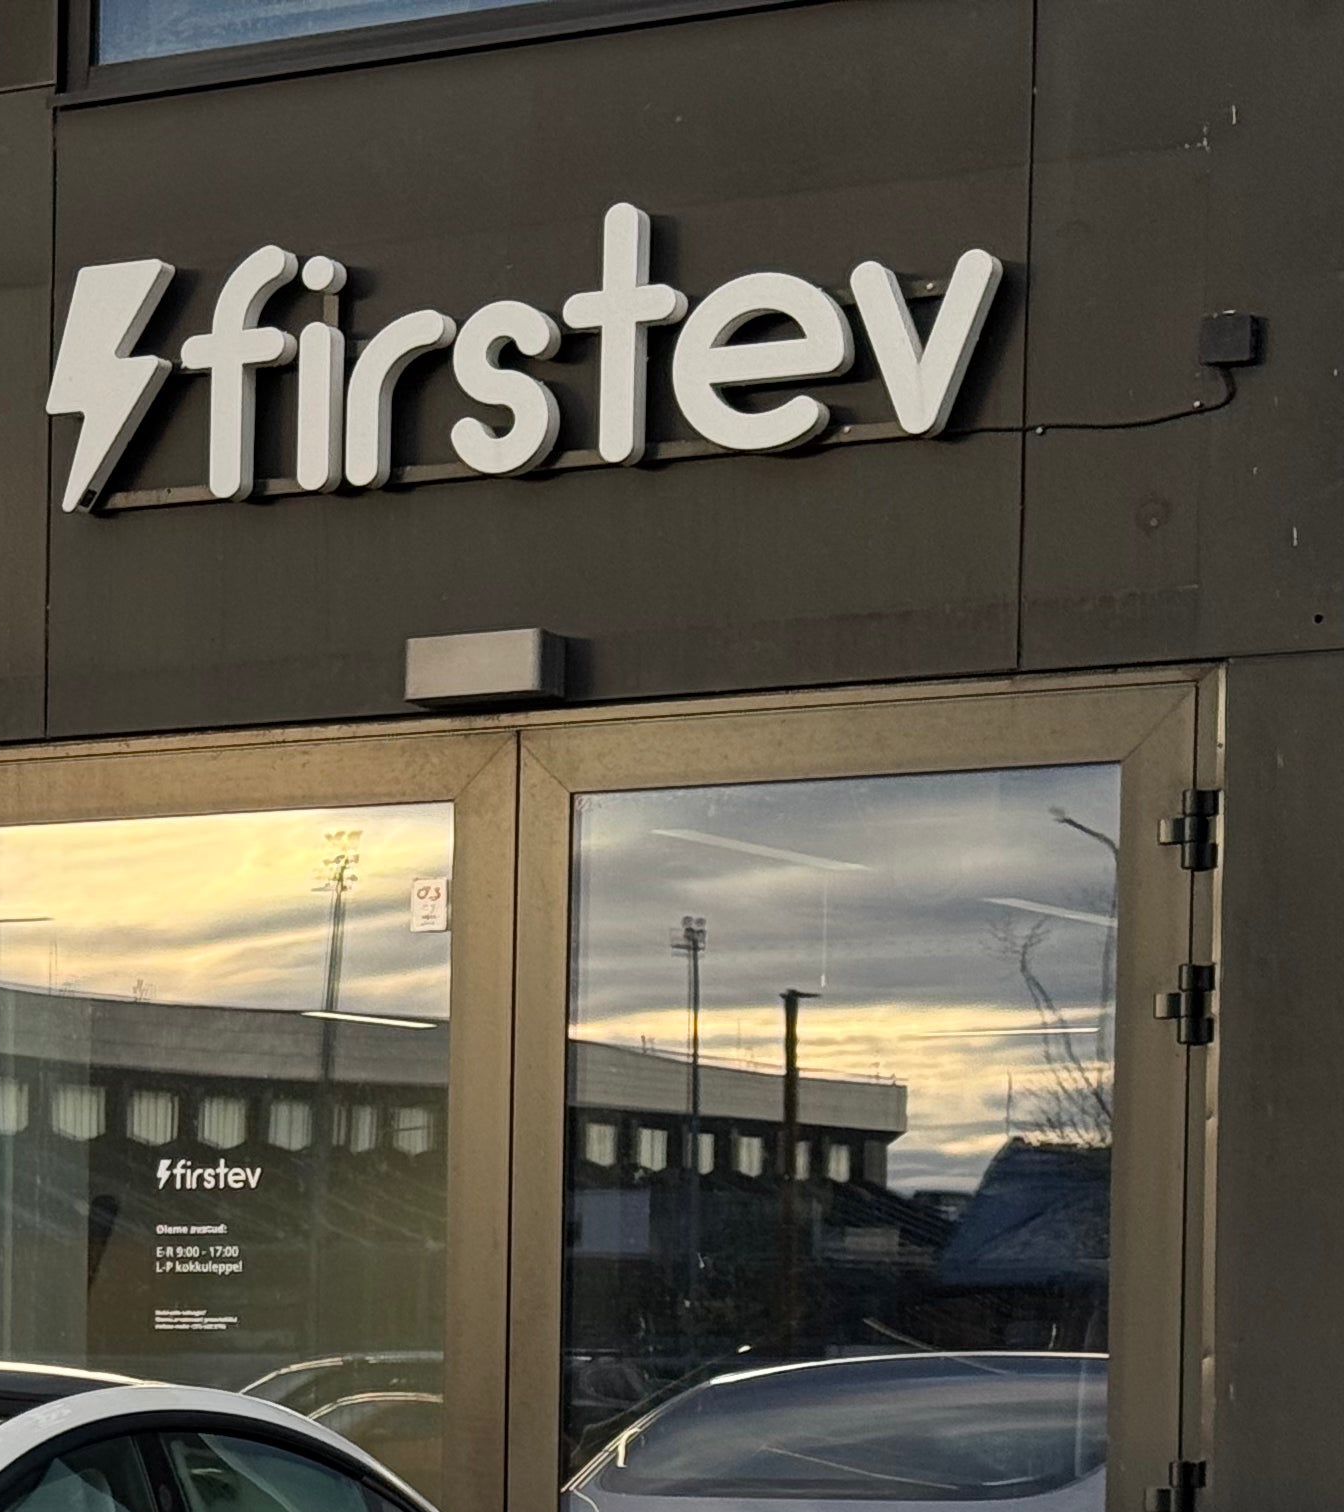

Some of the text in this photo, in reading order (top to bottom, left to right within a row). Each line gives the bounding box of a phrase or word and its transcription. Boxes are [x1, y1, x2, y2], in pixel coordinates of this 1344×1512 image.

[180, 202, 1004, 501] firstev
[173, 1158, 262, 1190] firstev
[175, 1246, 200, 1258] 9:00
[209, 1246, 240, 1258] 17:00
[155, 1260, 243, 1276] L-P kokkuleppel
